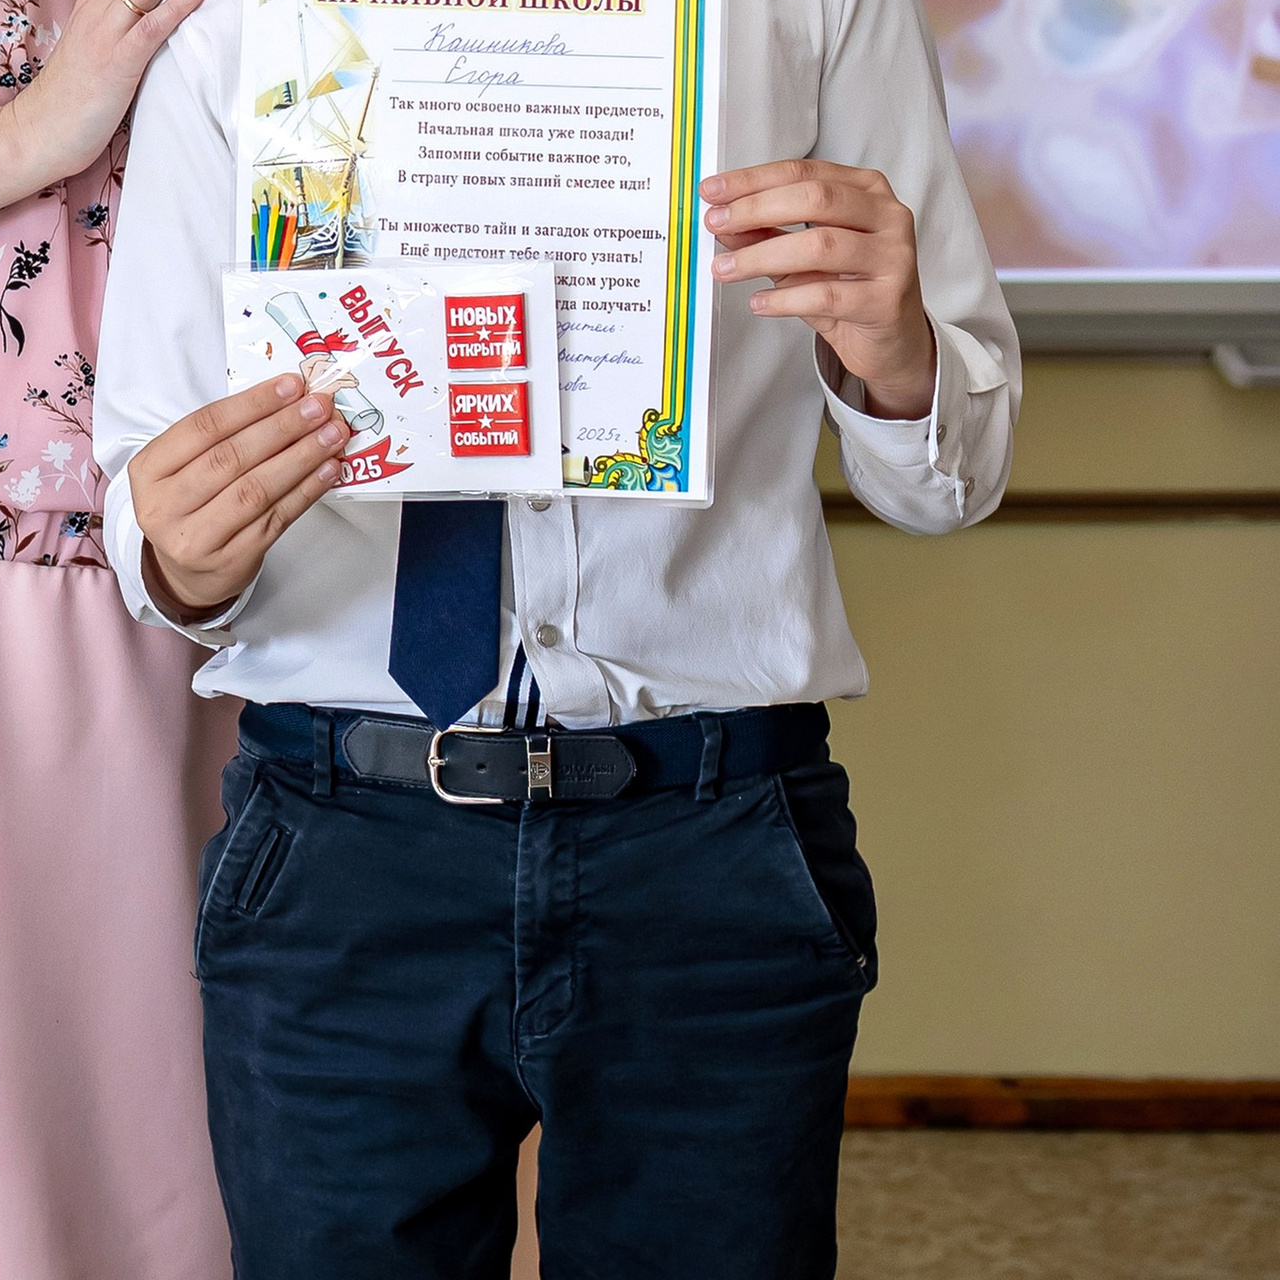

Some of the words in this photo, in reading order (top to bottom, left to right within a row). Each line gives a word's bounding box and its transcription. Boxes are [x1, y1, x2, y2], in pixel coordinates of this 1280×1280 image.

[445, 56, 524, 98] Егора
[389, 96, 414, 110] Так
[419, 99, 461, 111] много
[466, 100, 521, 113] освоено
[525, 102, 580, 115] важных
[585, 104, 664, 119] предметов,
[418, 121, 494, 137] Начальная
[499, 125, 544, 138] школа
[548, 126, 575, 141] уже
[579, 128, 634, 141] позади!
[418, 146, 481, 161] Запомни
[485, 146, 544, 163] событие
[548, 151, 600, 164] важное
[604, 153, 631, 167] это,
[398, 170, 407, 183] В
[411, 172, 457, 187] страну
[462, 173, 505, 186] новых
[510, 173, 561, 188] знаний
[566, 176, 615, 189] смелее
[620, 177, 651, 190] иди!
[378, 218, 398, 231] Ты
[403, 221, 480, 234] множество
[484, 222, 516, 236] тайн
[521, 225, 529, 236] и
[534, 225, 589, 238] загадок
[594, 227, 666, 241] откроешь,
[400, 242, 429, 257] Ещё
[434, 246, 505, 261] предстоит
[510, 246, 539, 260] тебе
[545, 249, 586, 262] много
[591, 251, 643, 264] узнать!
[554, 275, 596, 287] ждом
[600, 277, 641, 290] уроке
[449, 305, 518, 327] НОВЫХ
[555, 300, 577, 312] гда
[582, 300, 651, 314] получать!
[448, 341, 521, 358] ОТКРЫТЙ
[455, 394, 515, 414] ЯРКИХ
[454, 431, 519, 447] СОБЫТИЙ
[334, 454, 383, 485] 025
